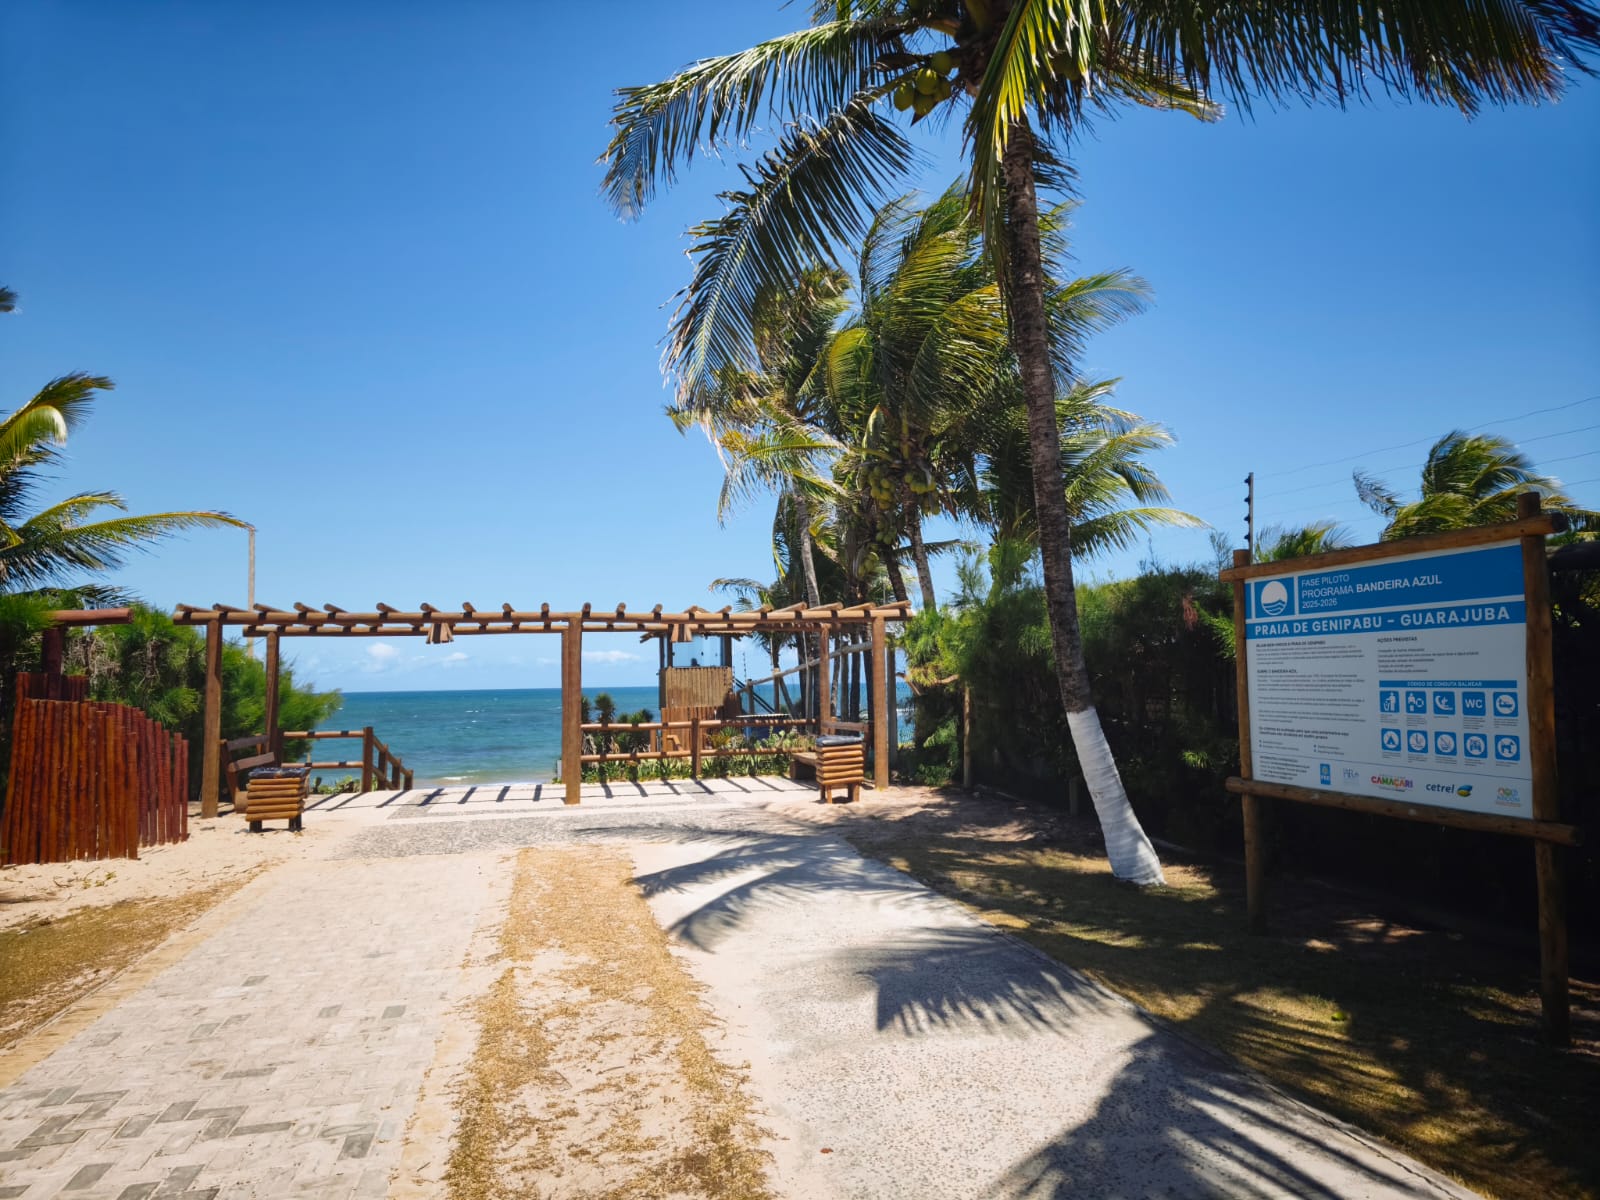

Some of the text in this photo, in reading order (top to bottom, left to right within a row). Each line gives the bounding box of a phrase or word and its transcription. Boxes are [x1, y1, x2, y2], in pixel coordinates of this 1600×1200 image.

[1302, 574, 1350, 586] FASE PILOTO
[1302, 574, 1442, 598] PROGRAMA BANDEIRA AZUL
[1302, 598, 1338, 608] 2025-2026
[1255, 622, 1288, 635] PRAIA
[1293, 620, 1308, 633] DE
[1312, 615, 1382, 631] GENIPABU
[1400, 606, 1510, 626] GUARAJUBA
[1465, 699, 1483, 709] WC
[1426, 782, 1454, 794] cetrel
